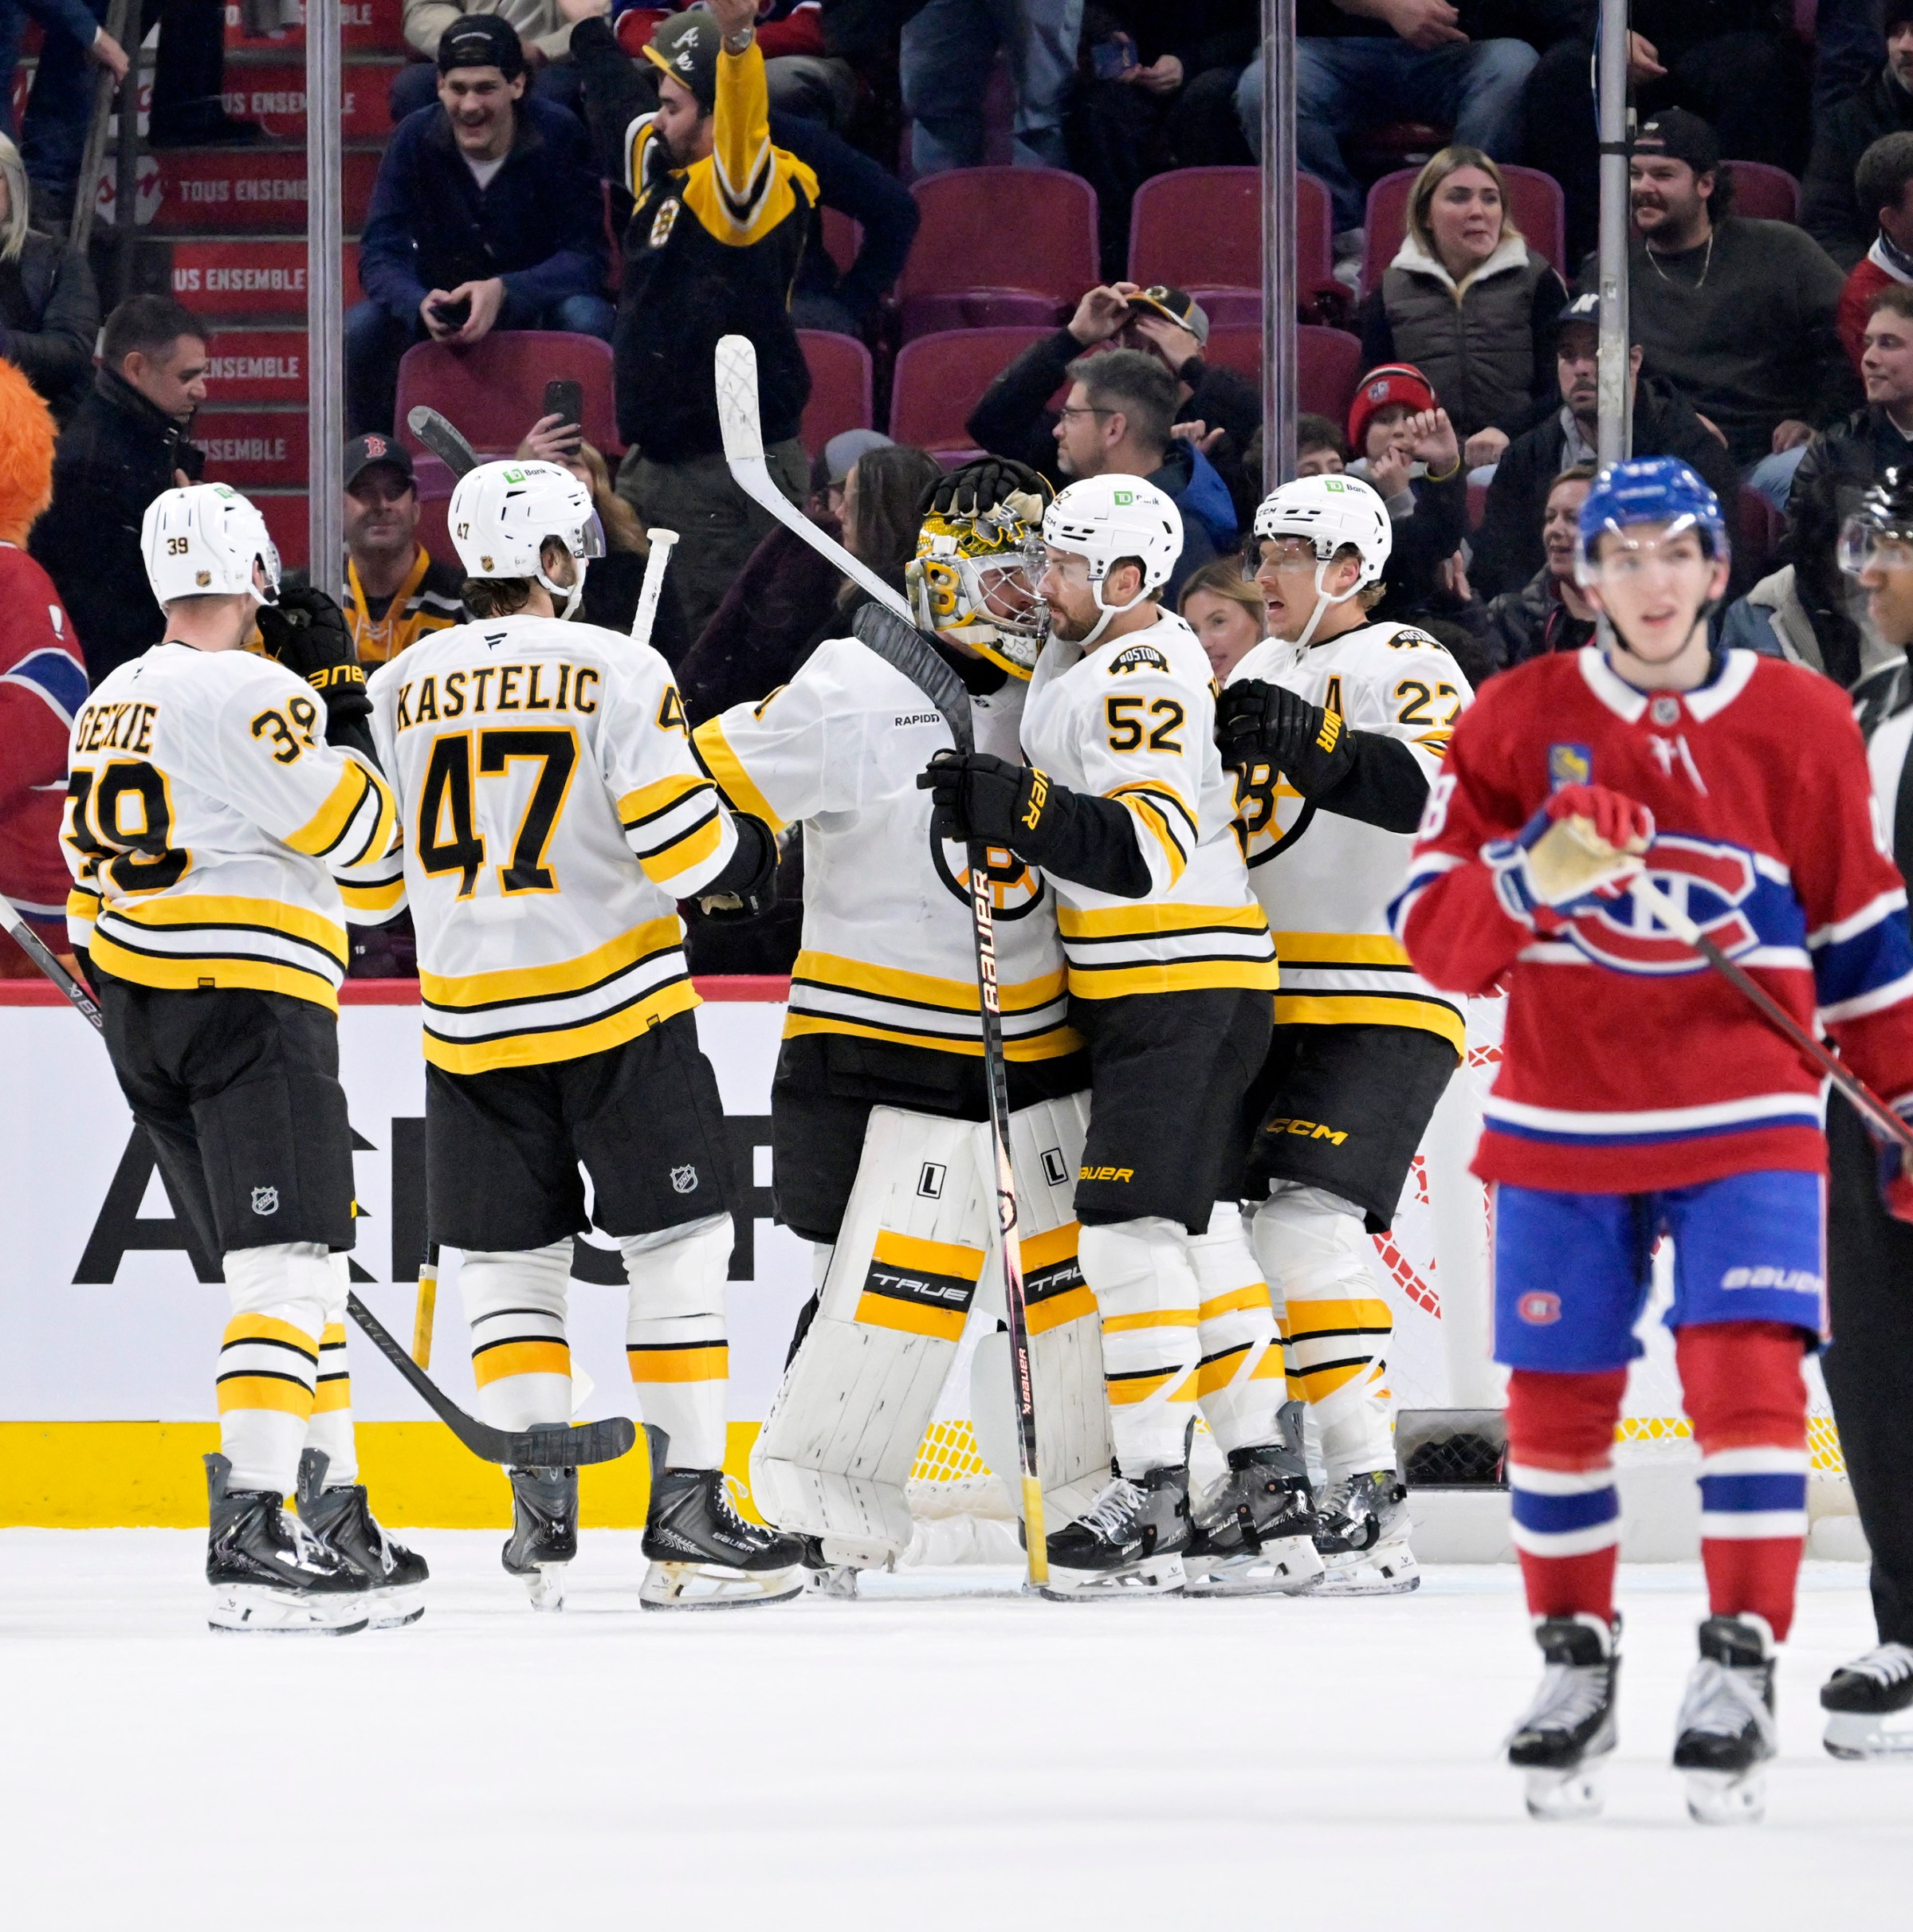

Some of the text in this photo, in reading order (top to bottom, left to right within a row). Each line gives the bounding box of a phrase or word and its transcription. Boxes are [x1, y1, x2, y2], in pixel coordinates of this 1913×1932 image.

[221, 92, 246, 114] US
[179, 179, 308, 202] TOUS ENSEMB
[173, 269, 306, 291] US ENSEMBLE
[194, 439, 287, 461] NSEMBLE
[364, 437, 387, 459] B
[1114, 491, 1133, 505] TD
[1325, 481, 1345, 493] TD
[1259, 508, 1277, 517] CCM
[457, 523, 469, 540] 47
[167, 537, 189, 556] 39
[1119, 646, 1161, 664] BOSTON
[397, 662, 600, 732] KASTELIC
[1393, 678, 1462, 728] 27
[249, 695, 318, 766] 39
[1104, 695, 1187, 757] 52
[414, 726, 580, 902] 47
[972, 868, 1001, 1014] BAUER
[1265, 1117, 1349, 1146] CCM
[1078, 1165, 1135, 1184] AUER
[871, 1273, 970, 1302] TRUE
[1027, 1264, 1083, 1293] TRU
[348, 1303, 408, 1365] FLYLITE
[1018, 1346, 1031, 1404] BAUER
[712, 1531, 756, 1554] BAUER
[1121, 1537, 1142, 1556] BAU
